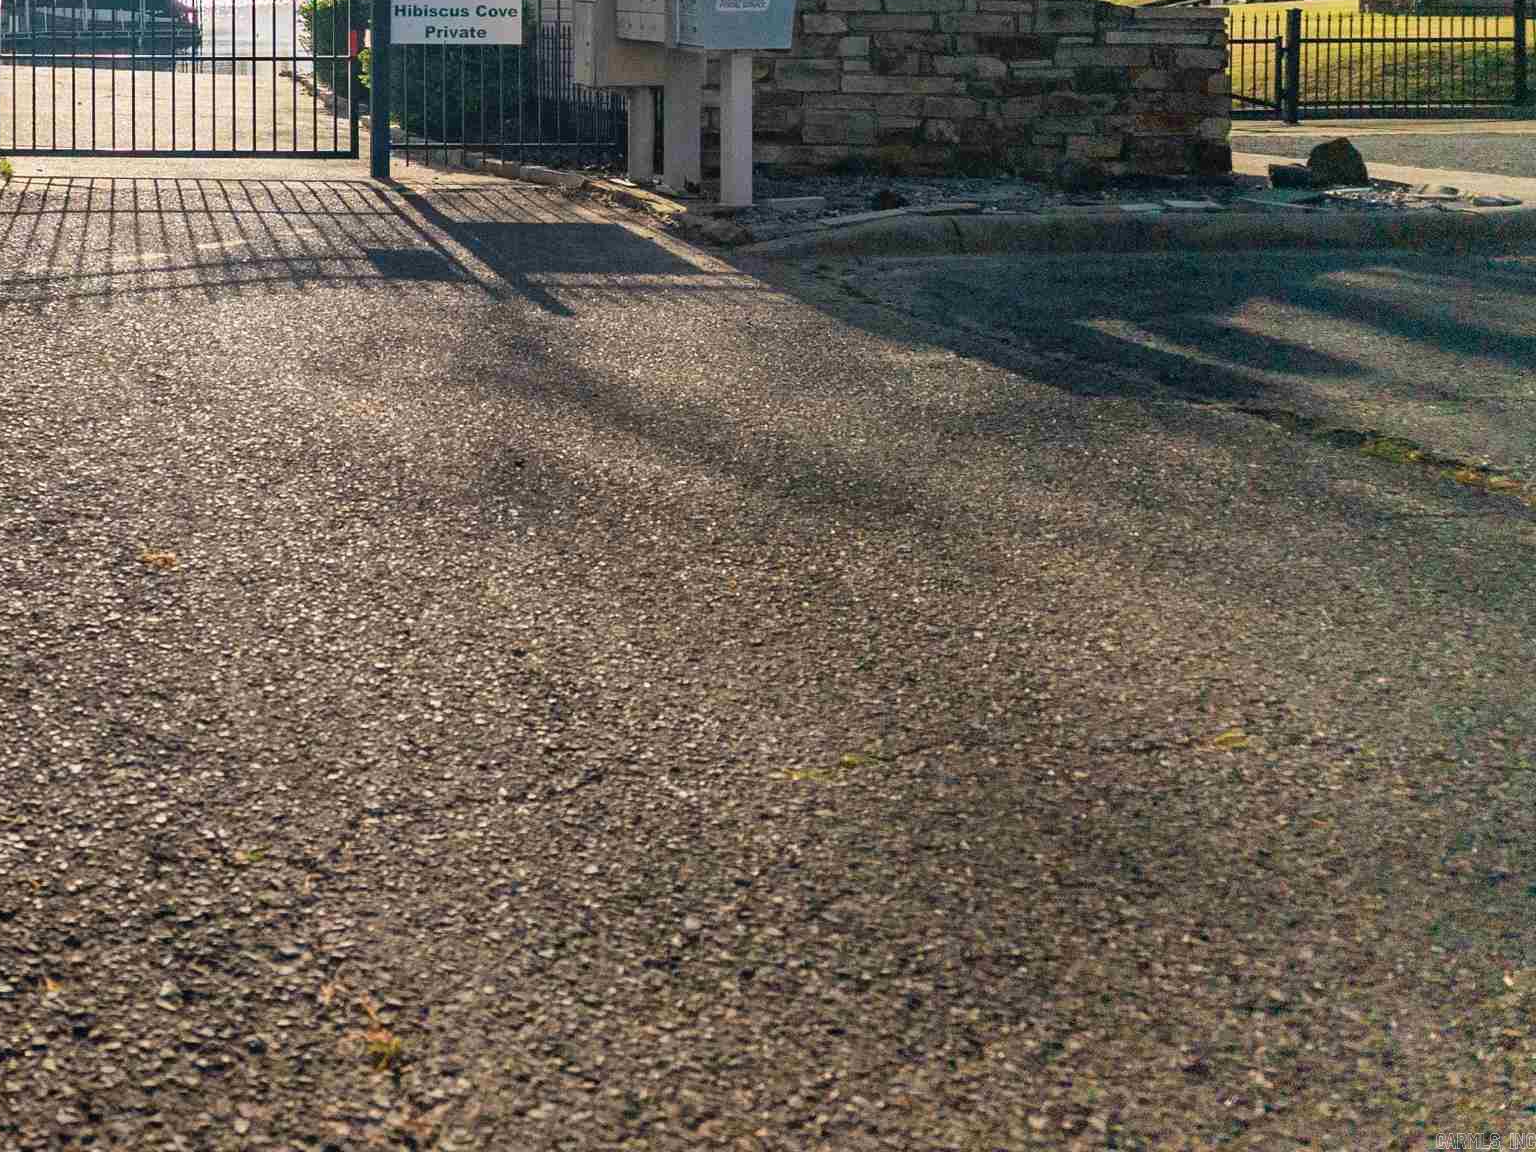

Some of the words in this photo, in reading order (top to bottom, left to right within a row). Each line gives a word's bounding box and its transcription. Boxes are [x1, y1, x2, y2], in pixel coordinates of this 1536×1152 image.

[394, 4, 470, 17] Hibiscus
[476, 4, 518, 17] Cove
[425, 26, 487, 39] Private
